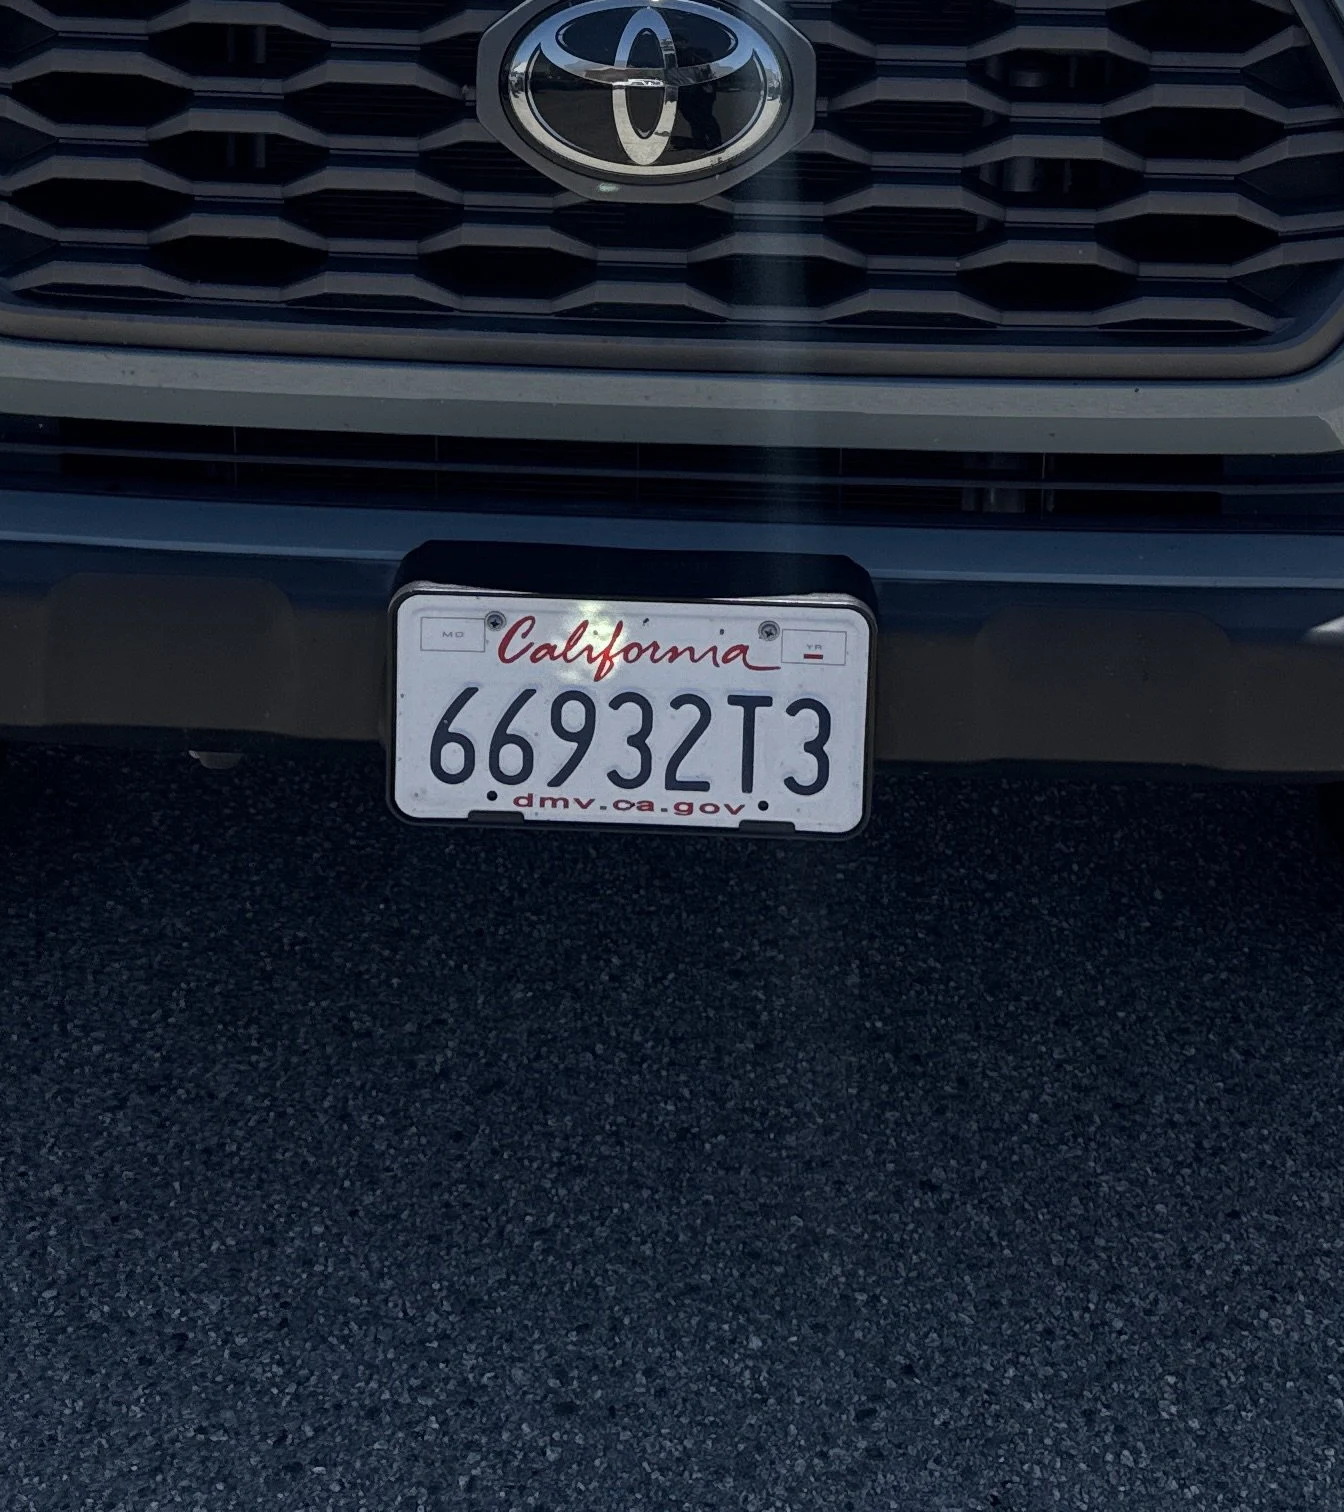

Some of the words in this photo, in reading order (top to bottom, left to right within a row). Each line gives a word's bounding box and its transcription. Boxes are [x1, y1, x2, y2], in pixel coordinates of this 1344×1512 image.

[497, 615, 781, 682] California
[429, 687, 832, 797] 66932T3
[512, 792, 746, 817] dmv.ca.gov
